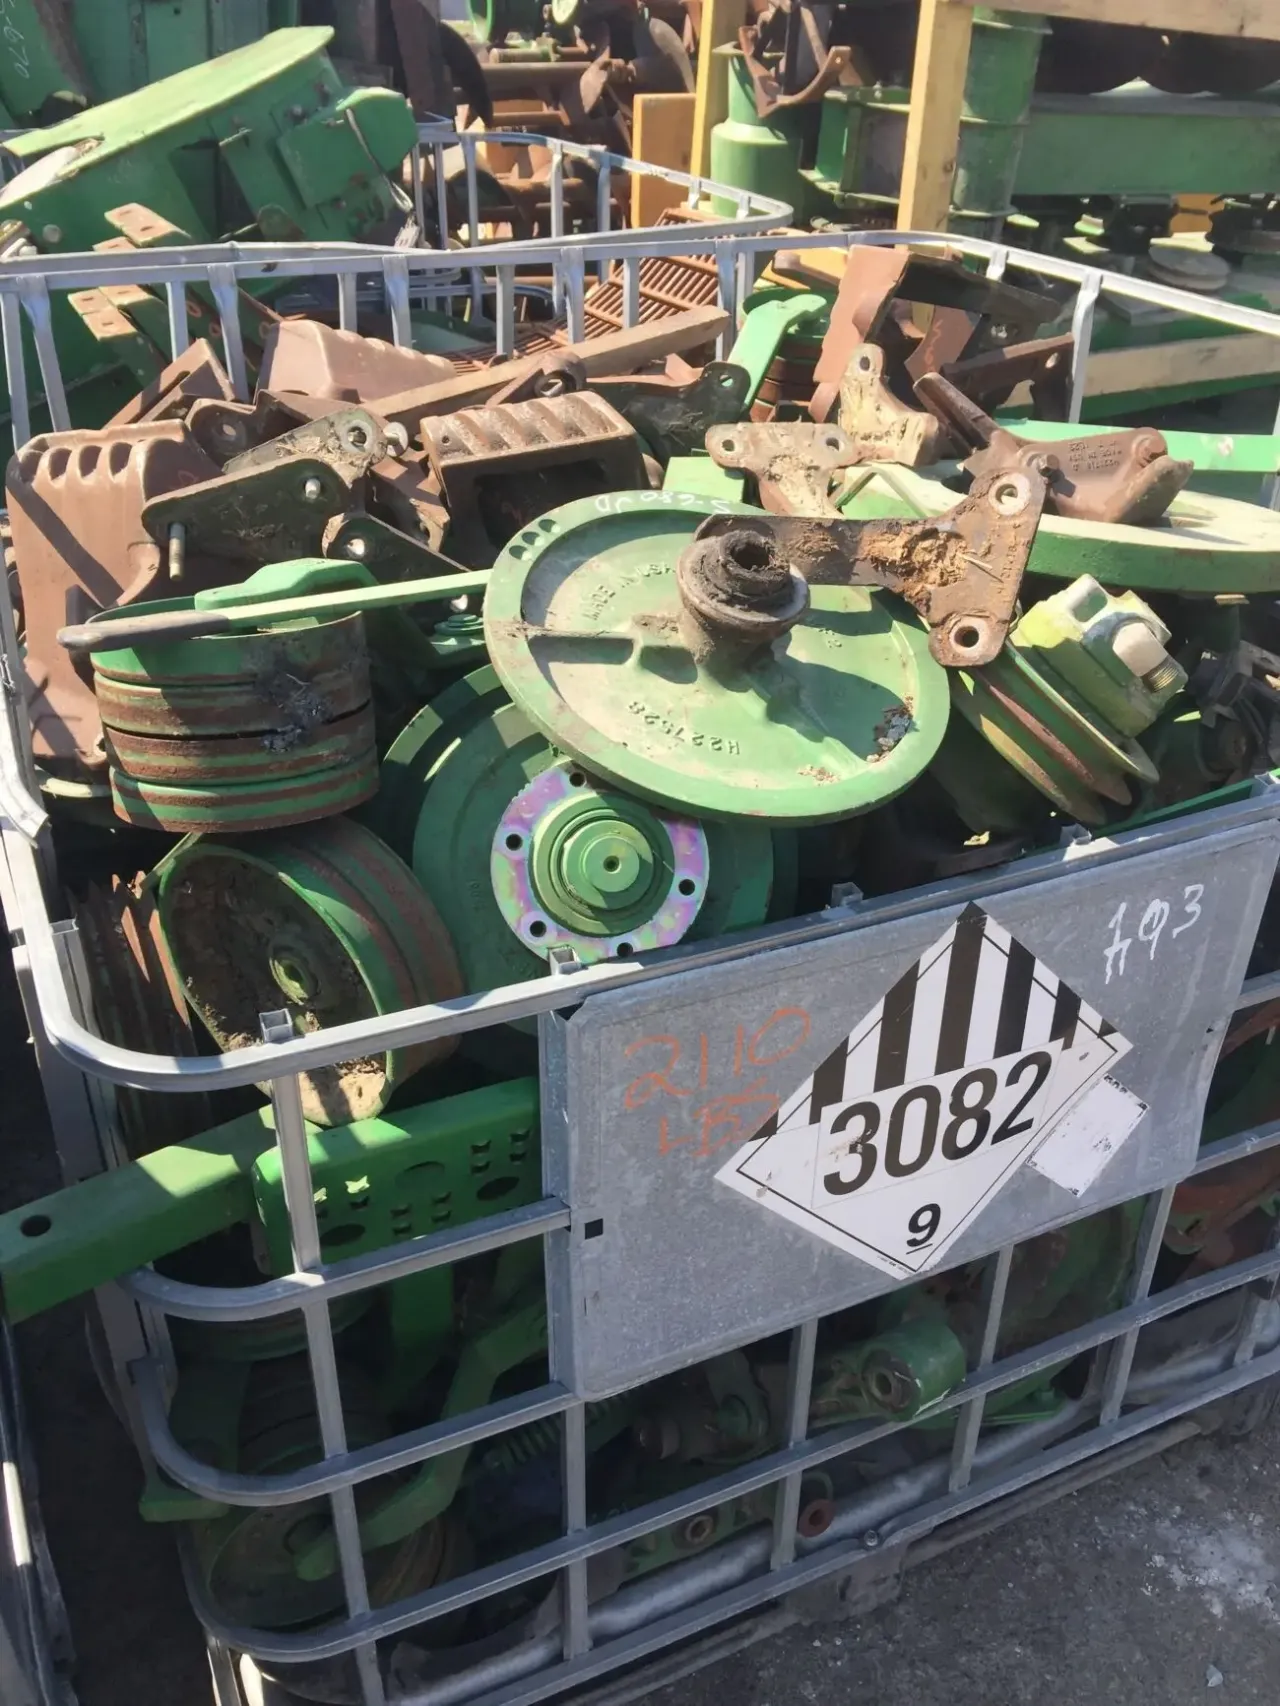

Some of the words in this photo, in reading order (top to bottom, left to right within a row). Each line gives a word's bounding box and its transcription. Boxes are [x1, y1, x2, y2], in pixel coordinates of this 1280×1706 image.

[624, 1006, 811, 1113] 2110
[823, 1050, 1052, 1196] 3082
[906, 1203, 941, 1248] 9
